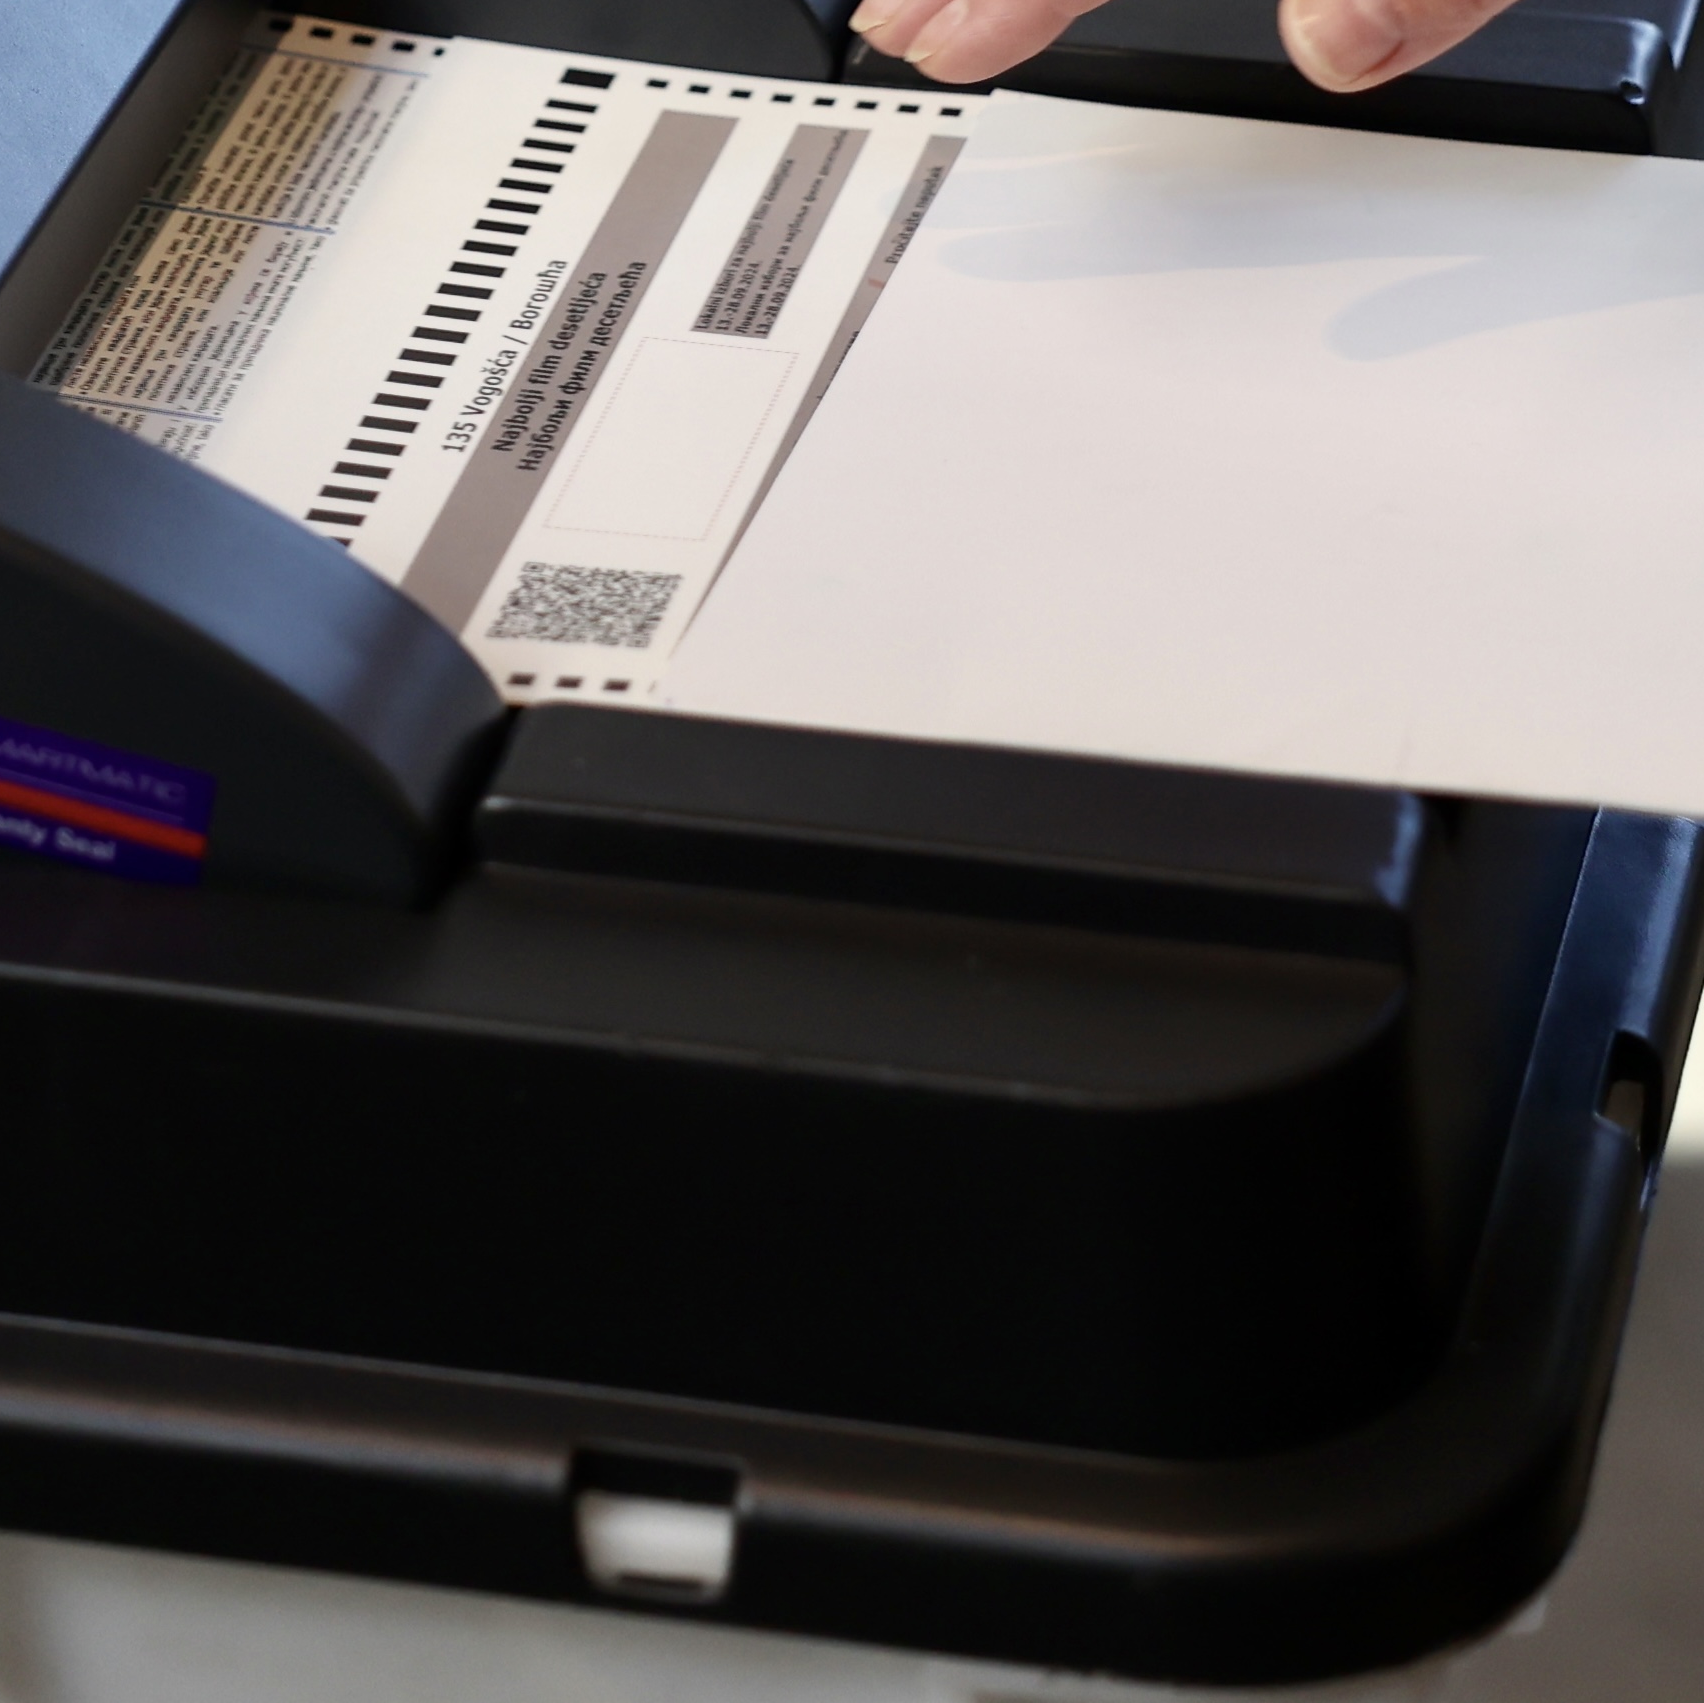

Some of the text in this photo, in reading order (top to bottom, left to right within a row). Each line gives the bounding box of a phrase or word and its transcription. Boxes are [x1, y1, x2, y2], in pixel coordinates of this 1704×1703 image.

[442, 260, 567, 452] 135 Vogošća / Вогошћа
[695, 297, 723, 329] Lokalni
[731, 257, 744, 268] za
[734, 293, 766, 334] Локални
[760, 258, 783, 291] избори
[777, 245, 790, 256] за
[492, 273, 607, 452] Najbolji film desetljeća
[517, 262, 646, 471] Најбољи филм десетљећа
[55, 826, 116, 861] Seal
